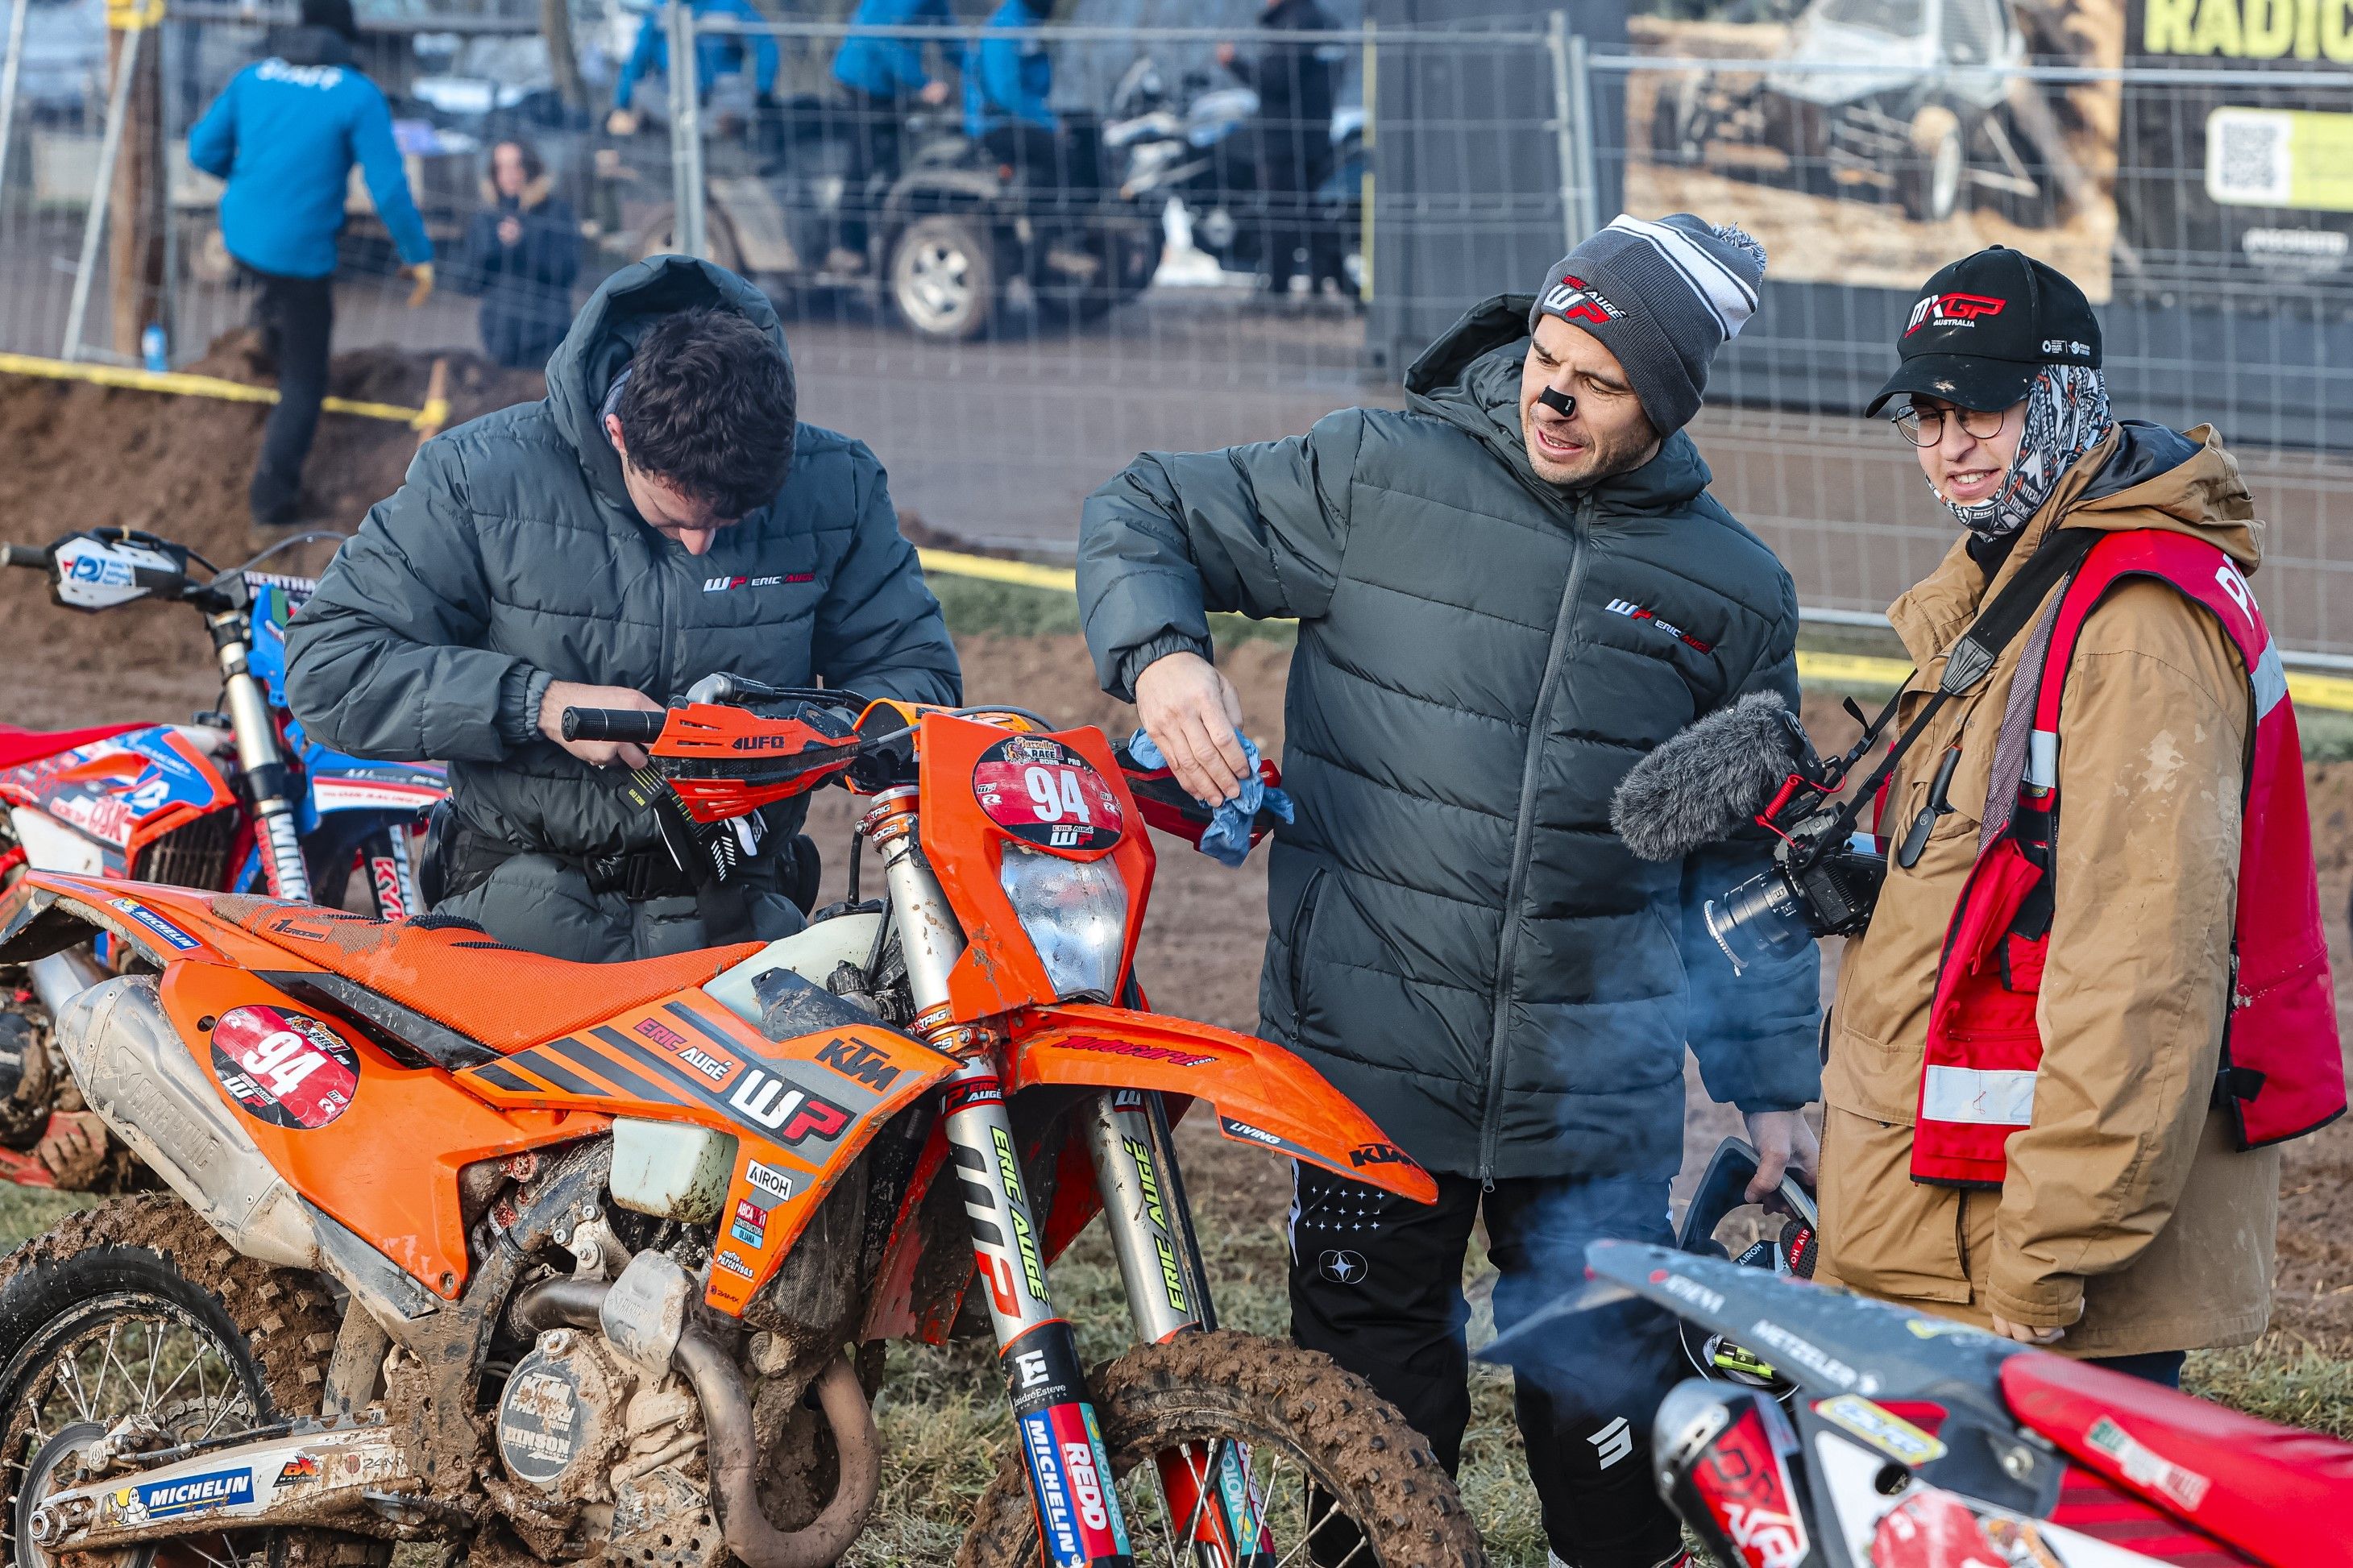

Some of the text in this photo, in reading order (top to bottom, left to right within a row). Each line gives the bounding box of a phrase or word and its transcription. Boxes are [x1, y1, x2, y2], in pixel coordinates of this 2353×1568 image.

[1933, 318, 1975, 328] AUSTRALIA
[703, 576, 748, 592] WP
[751, 576, 782, 587] ERIC
[1605, 598, 1653, 620] WP
[1654, 619, 1682, 637] ERIC
[742, 736, 784, 749] UFO
[1031, 749, 1056, 759] RACE
[1068, 758, 1081, 766] PRO
[1024, 766, 1090, 823] 94
[1049, 832, 1093, 845] WP
[137, 910, 194, 948] MICHELIN
[243, 1031, 328, 1097] 94
[633, 1017, 732, 1081] ERIC AUGÉ
[815, 1036, 901, 1092] KTM
[222, 1076, 267, 1107] WP
[967, 1089, 1002, 1102] AUGÉ
[969, 1083, 998, 1093] ERIC
[728, 1069, 848, 1140] WP
[1230, 1122, 1282, 1144] LIVING
[749, 1166, 789, 1196] AIROH
[738, 1201, 753, 1220] ABCA
[990, 1125, 1052, 1309] ERIC AUGÉ
[1121, 1134, 1188, 1315] ERIC AUGÉ
[735, 1217, 763, 1237] CONSTRUCTORA
[739, 1230, 755, 1244] OLIANA
[1739, 1243, 1763, 1266] AIROH
[149, 1475, 249, 1508] MICHELIN
[1029, 1420, 1076, 1553] MICHELIN
[1064, 1442, 1107, 1530] REDD
[1094, 1441, 1127, 1541] MOTOREX
